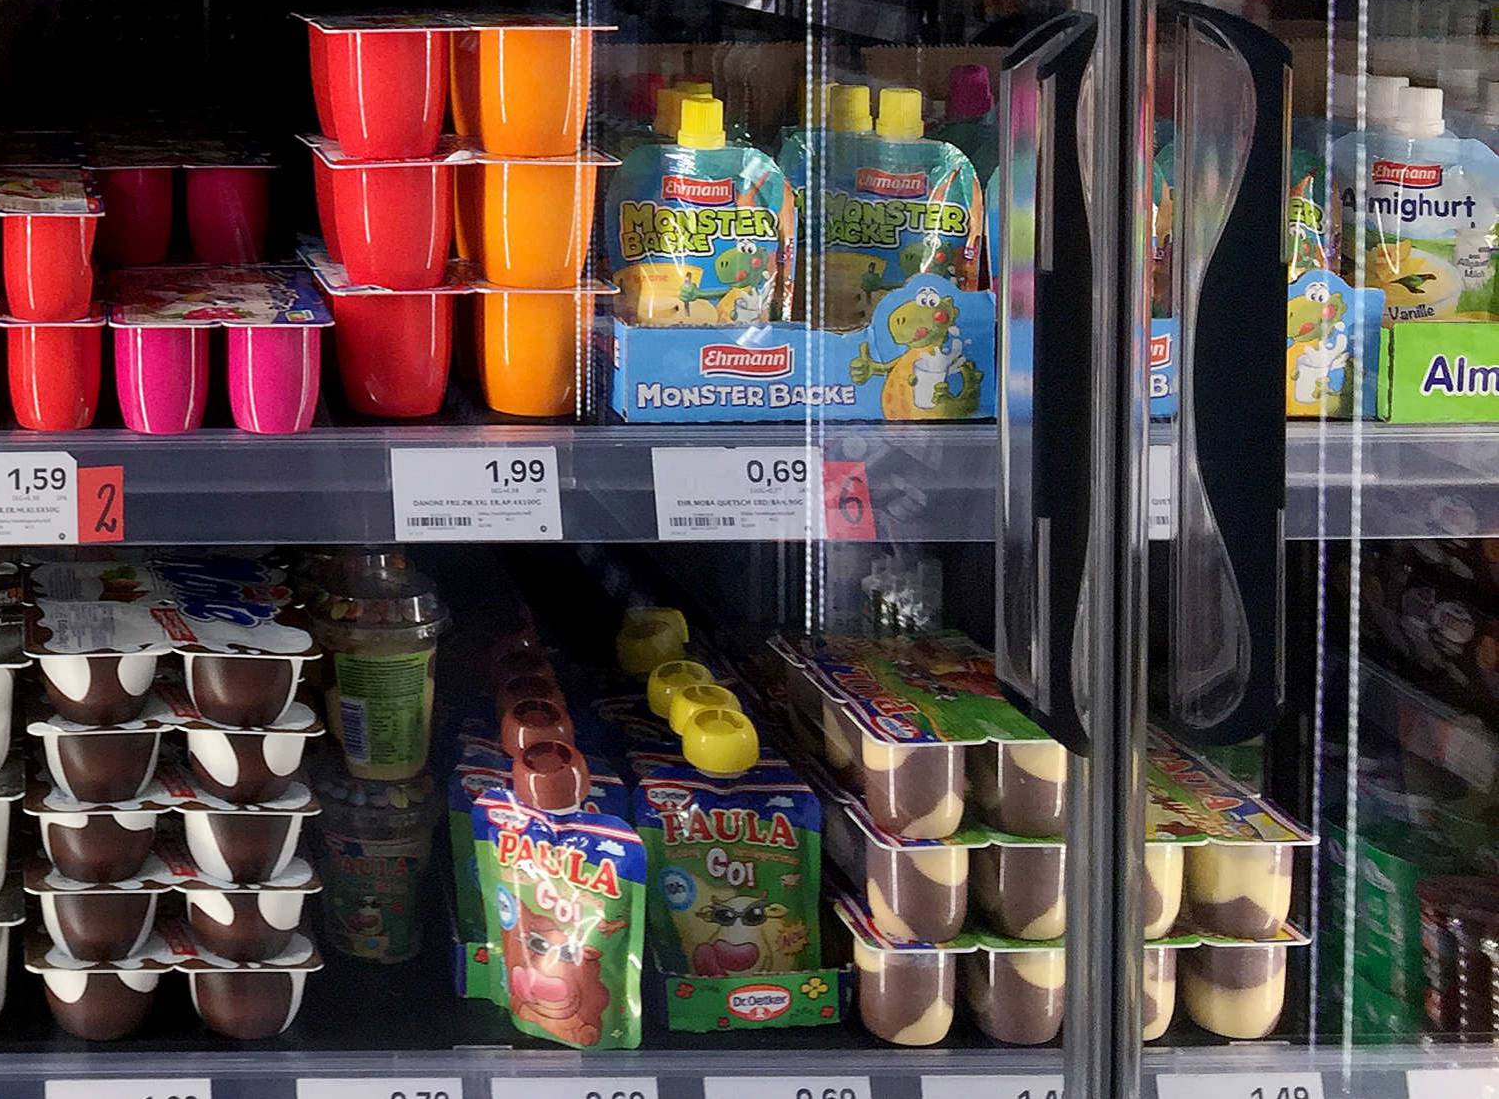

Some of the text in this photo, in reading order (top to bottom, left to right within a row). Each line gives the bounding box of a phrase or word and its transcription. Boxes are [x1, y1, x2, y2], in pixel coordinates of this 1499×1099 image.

[1375, 165, 1438, 182] Ehrmann
[664, 179, 731, 199] Ehrmann
[621, 202, 780, 238] MONSTER
[622, 230, 712, 259] BACKE
[1387, 303, 1436, 322] Vanille
[703, 349, 787, 370] Ehrmann
[636, 382, 858, 410] MONSTER BACKE
[6, 467, 67, 497] 1,59
[484, 459, 546, 488] 1,99
[746, 458, 809, 487] 0,69
[93, 482, 119, 534] 2
[838, 476, 867, 524] 6
[662, 808, 798, 850] PAULA
[498, 831, 622, 898] PAULA
[705, 847, 756, 888] GO!
